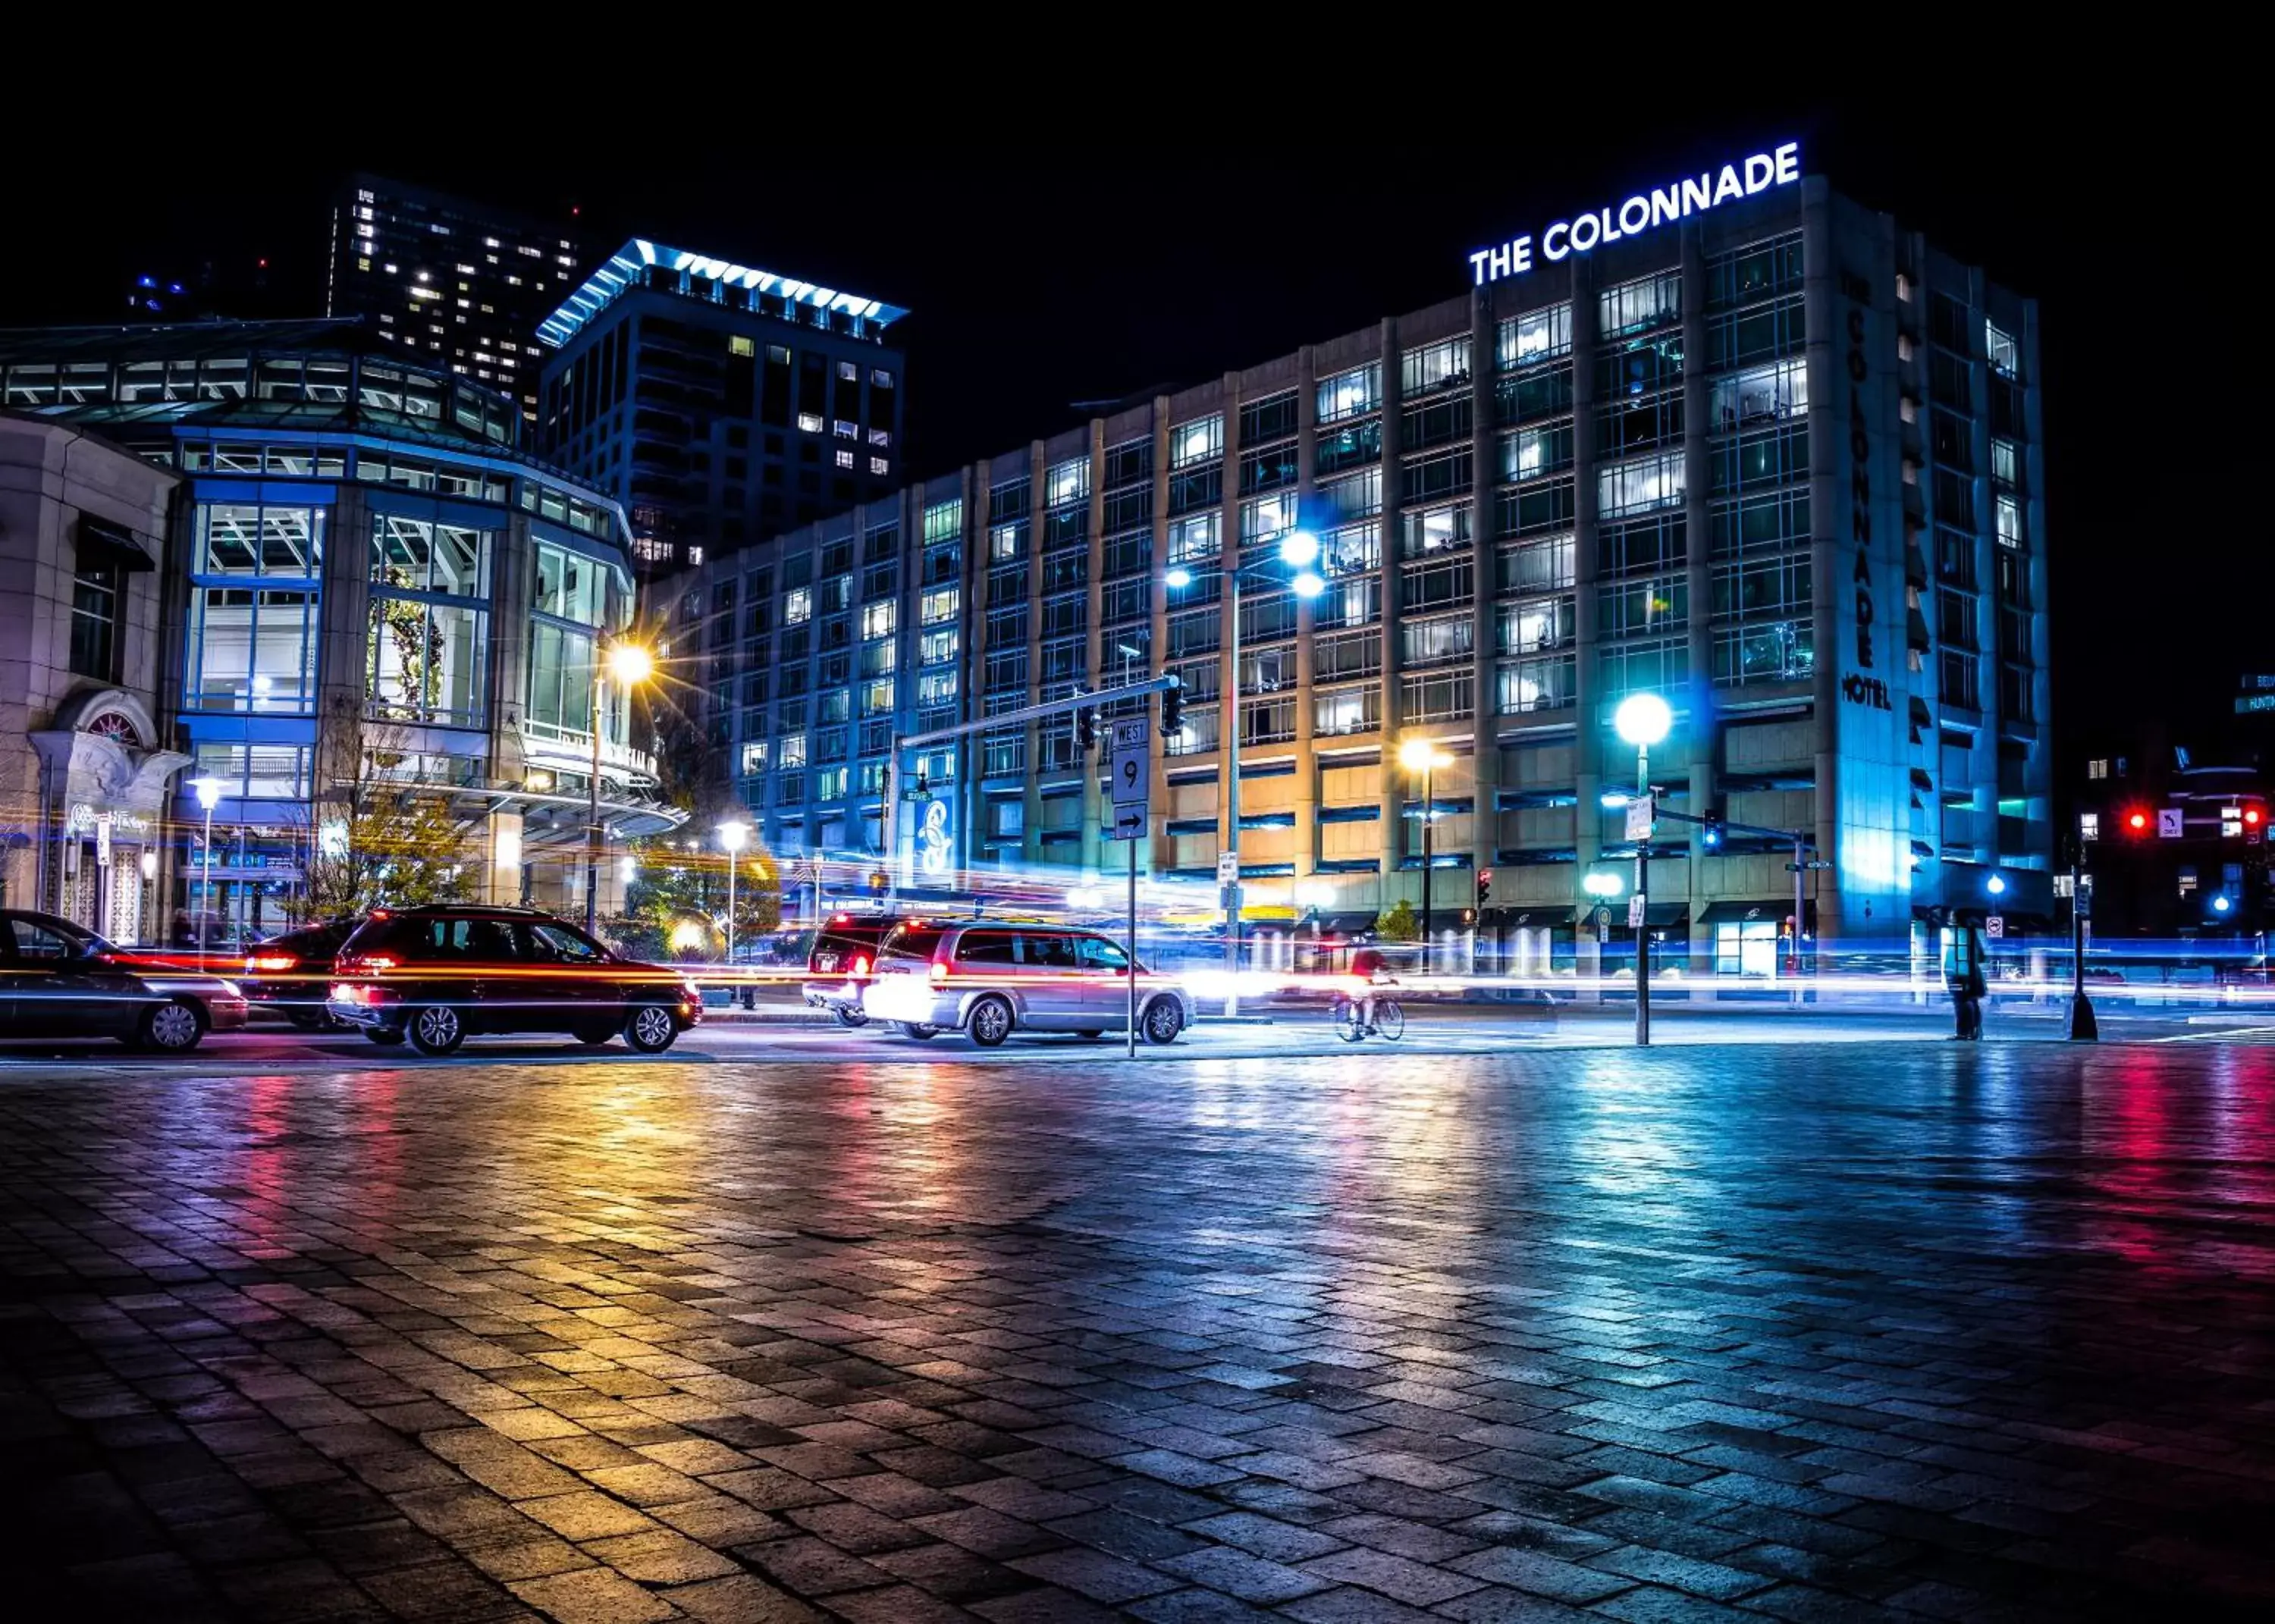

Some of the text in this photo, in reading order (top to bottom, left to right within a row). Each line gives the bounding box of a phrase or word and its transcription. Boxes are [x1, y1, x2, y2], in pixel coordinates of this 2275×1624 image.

[1470, 142, 1800, 286] THE COLONNADE
[1847, 309, 1873, 668] COLONNADE
[1841, 672, 1893, 711] HOTEL
[1119, 724, 1144, 741] WEST
[1124, 760, 1138, 788] 9
